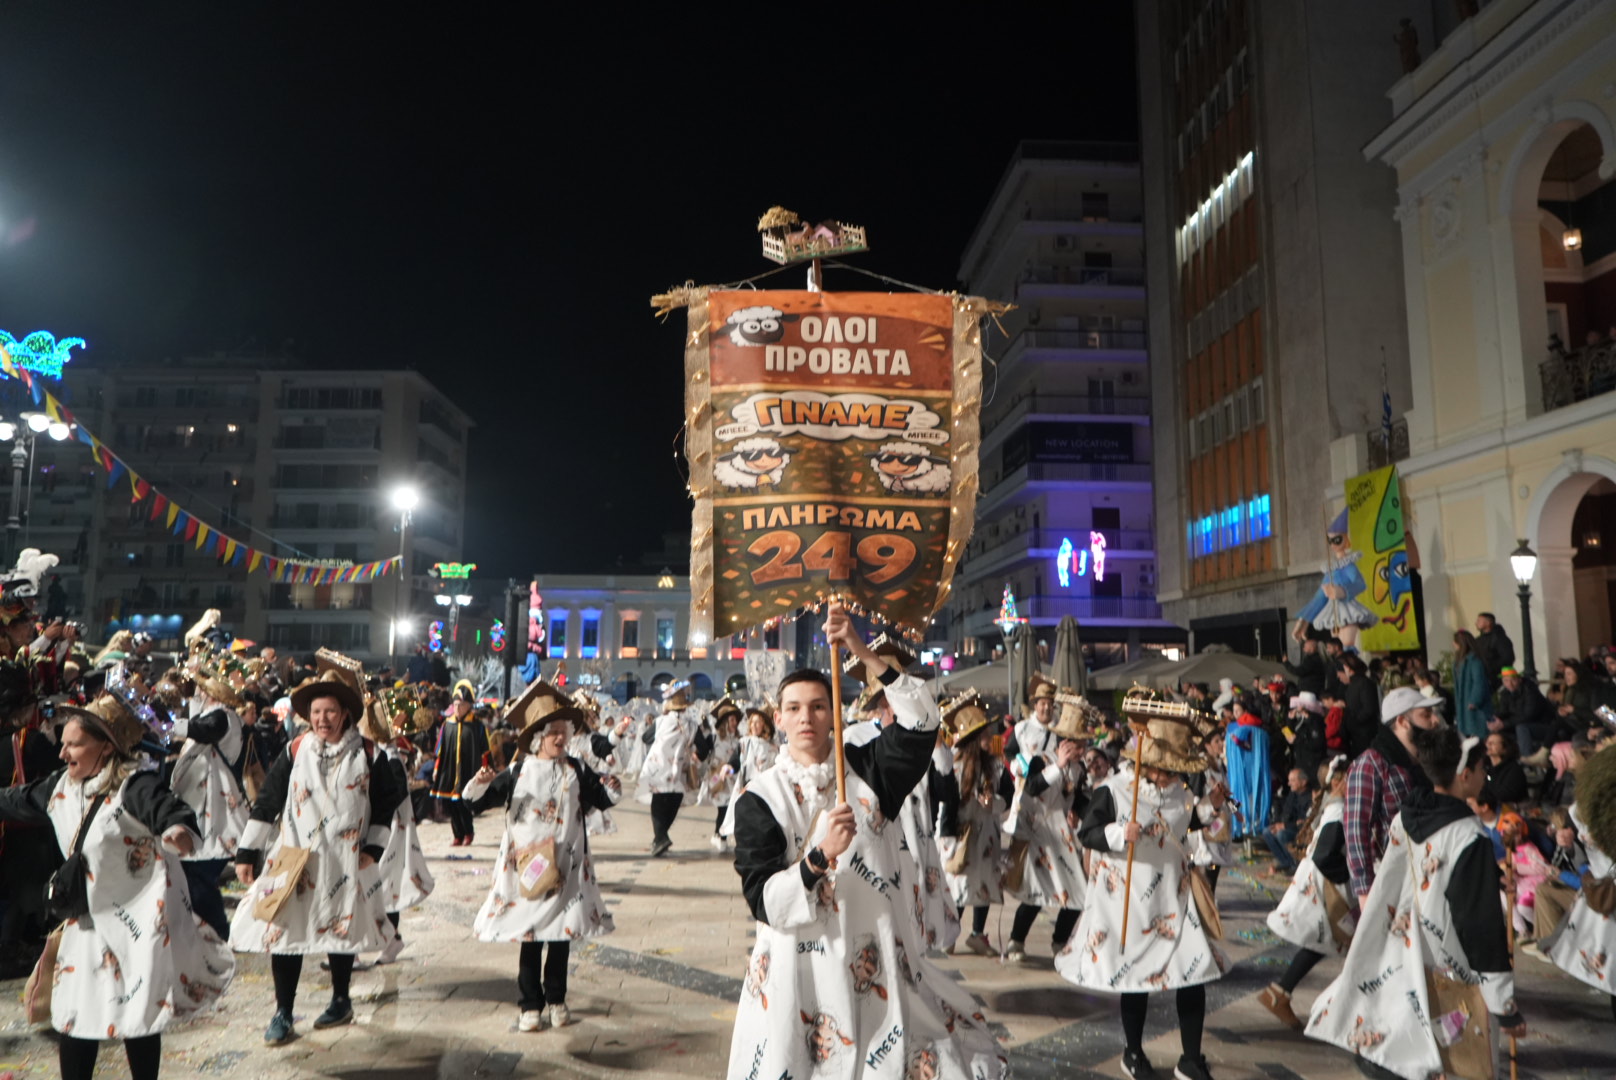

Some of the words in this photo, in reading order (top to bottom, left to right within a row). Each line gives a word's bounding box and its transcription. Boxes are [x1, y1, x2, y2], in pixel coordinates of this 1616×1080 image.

[800, 316, 877, 344] ΟΛΟΙ
[764, 345, 911, 376] ΠΡΟΒΑΤΑ
[753, 398, 912, 429] ΓΙΝΑΜΕ
[1045, 439, 1068, 448] NEW
[1071, 440, 1119, 449] LOCATION
[742, 504, 922, 531] ΠΛΗΡΩΜΑ
[747, 530, 916, 585] 249
